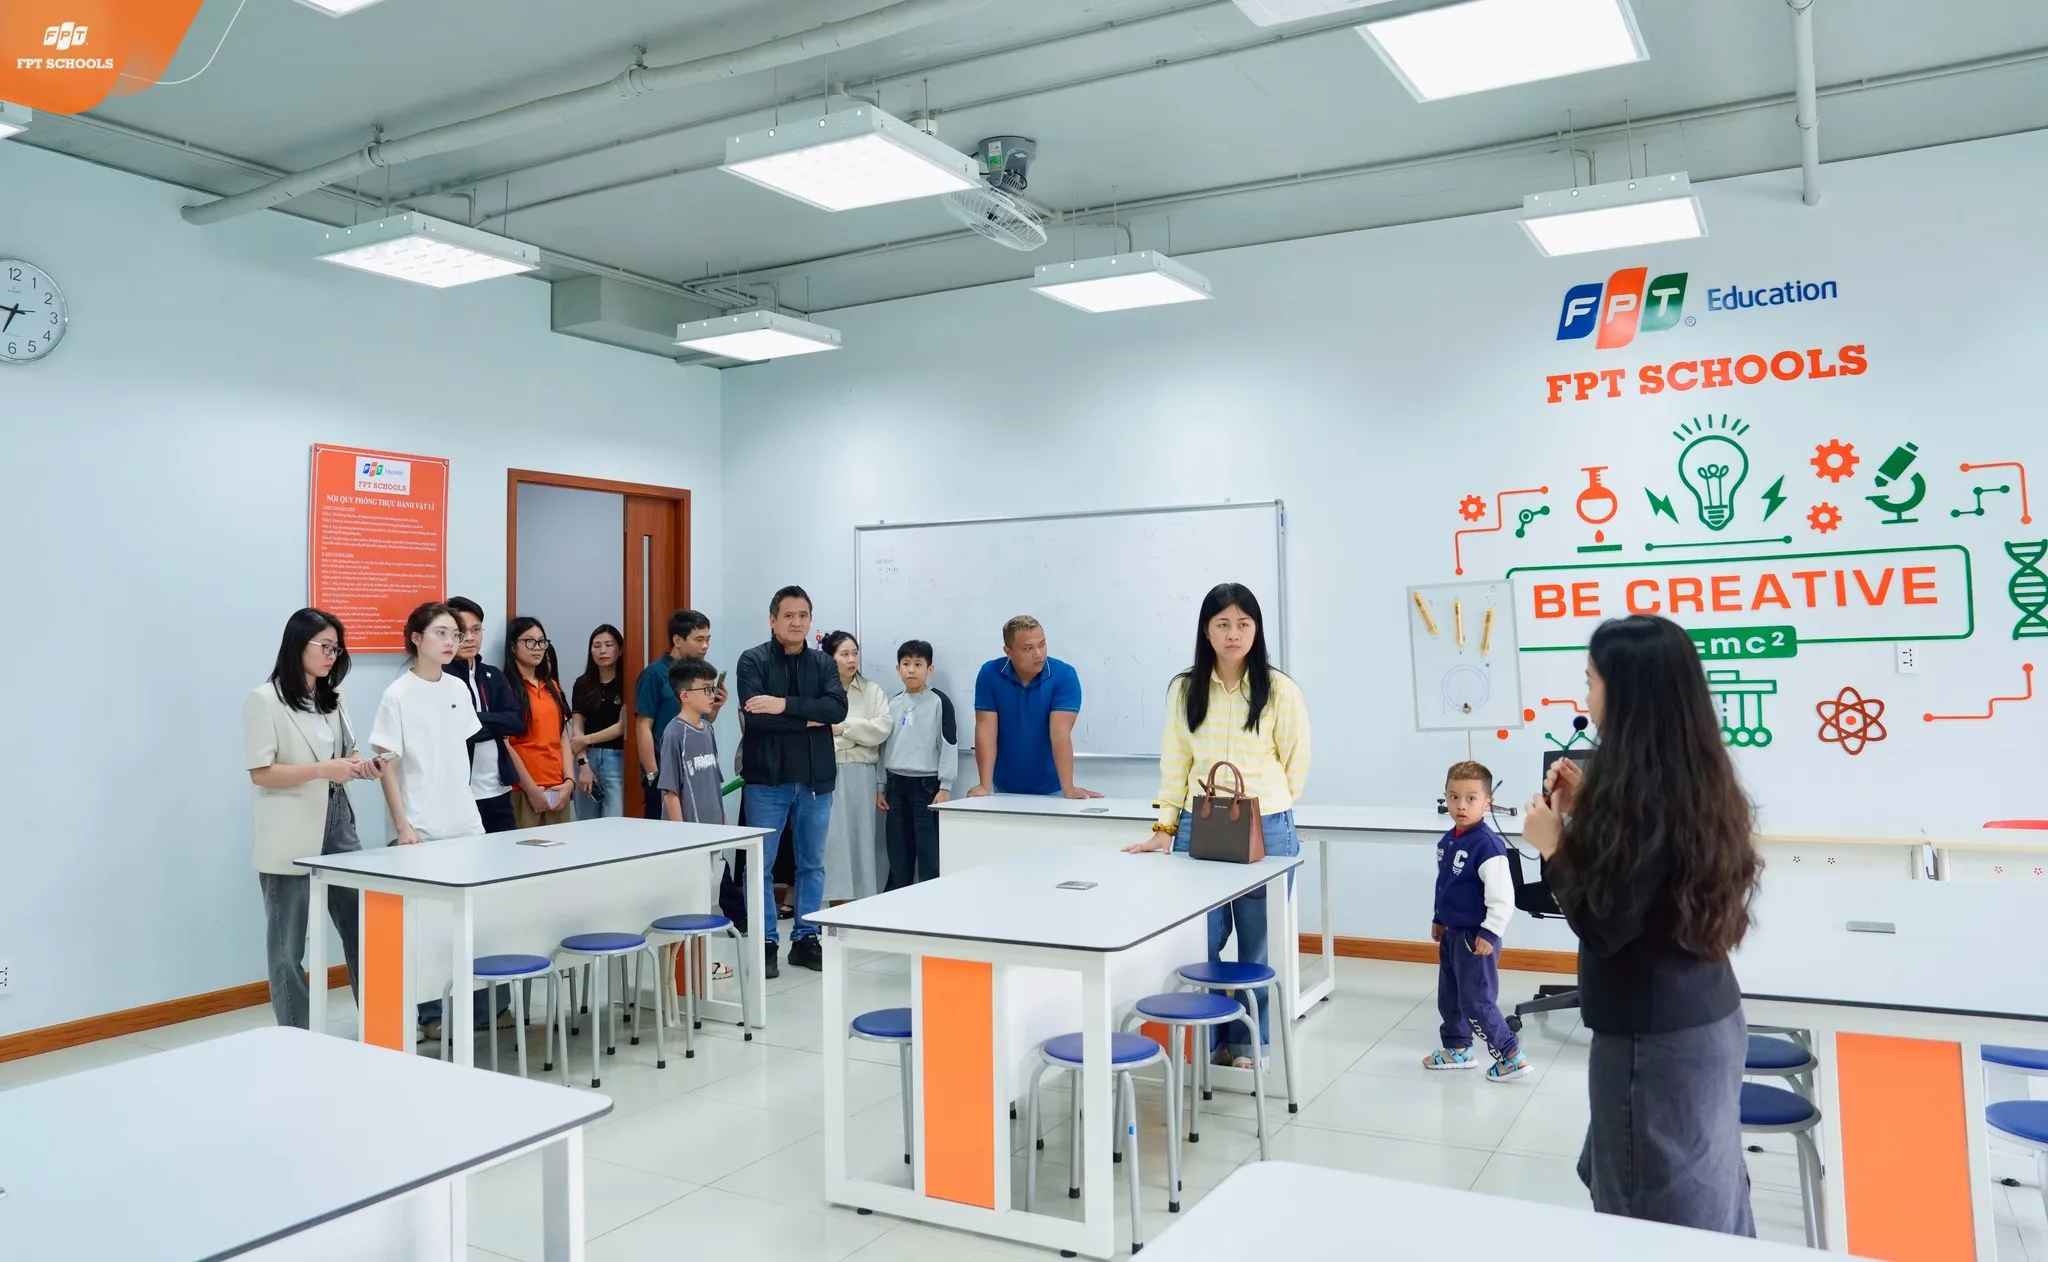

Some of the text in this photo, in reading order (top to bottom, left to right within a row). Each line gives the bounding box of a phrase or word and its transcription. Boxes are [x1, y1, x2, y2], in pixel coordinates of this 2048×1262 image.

[8, 267, 22, 282] 12
[32, 277, 37, 289] 1
[44, 292, 53, 305] 2
[1558, 275, 1838, 340] FPT Education
[49, 311, 58, 325] 3
[42, 329, 51, 342] 4
[7, 341, 17, 355] 6
[27, 340, 37, 353] 5
[1546, 344, 1868, 404] FPT SCHOOLS
[359, 480, 407, 492] FPT SCHOOLS
[326, 494, 339, 504] NỘI
[339, 495, 354, 504] QUY
[355, 496, 377, 506] PHÒNG
[378, 498, 396, 508] THỰC
[397, 500, 414, 509] HÀNH
[1533, 565, 1938, 619] BE CREATIVE
[1453, 849, 1469, 869] C
